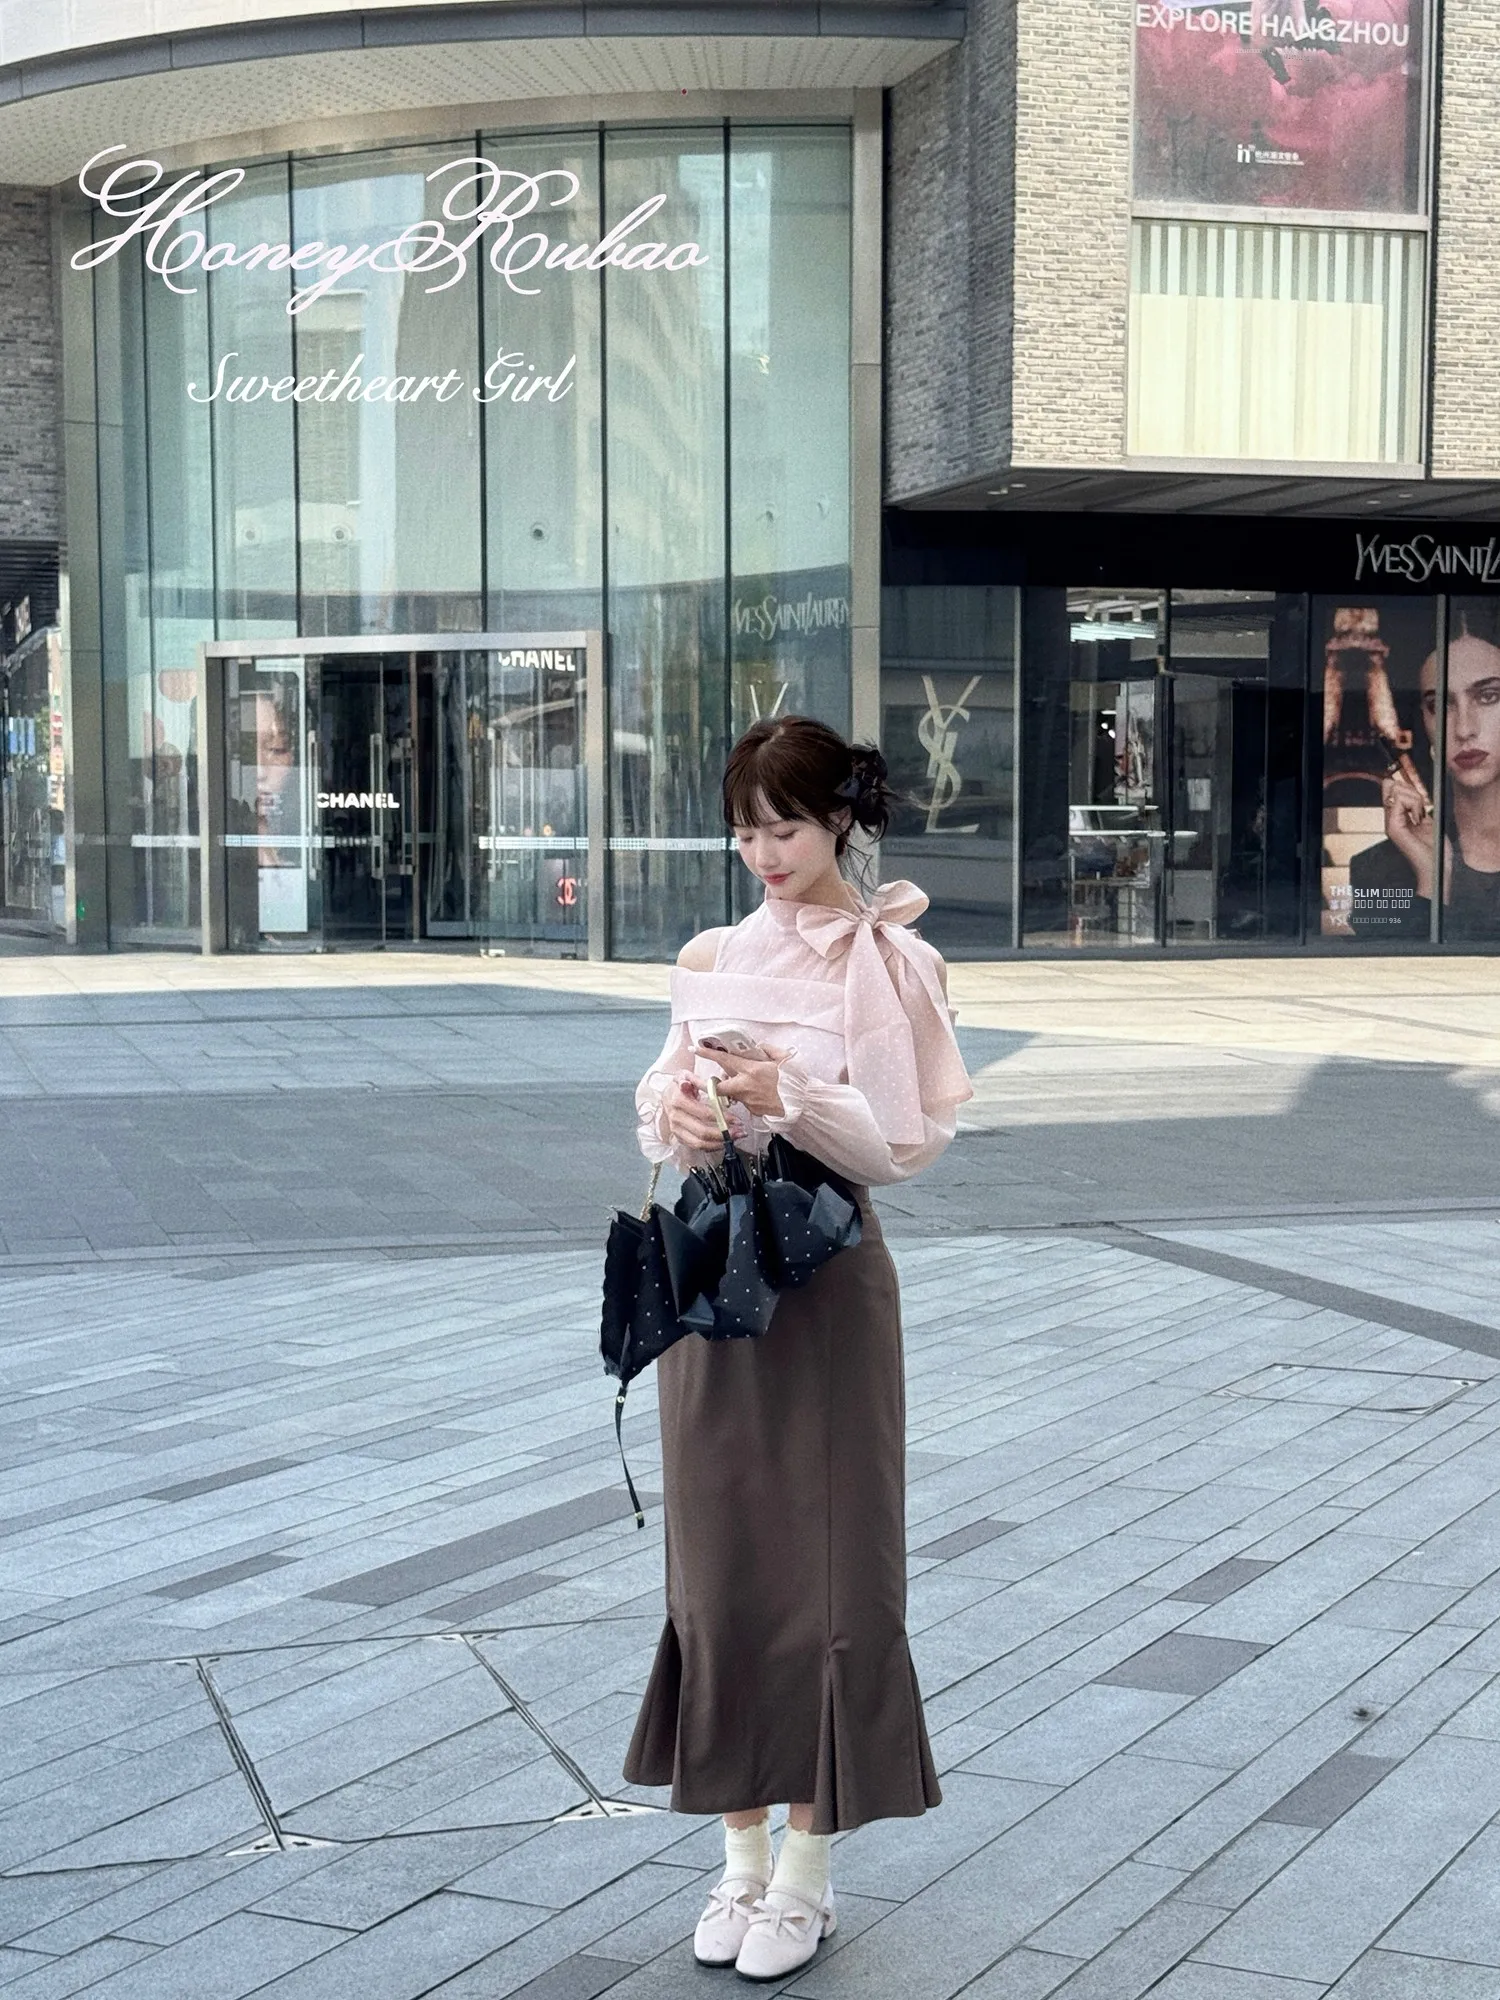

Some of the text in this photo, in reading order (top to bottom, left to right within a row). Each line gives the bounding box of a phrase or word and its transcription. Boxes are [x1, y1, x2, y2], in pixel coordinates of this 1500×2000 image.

[1136, 4, 1409, 47] EXPLORE HANGZHOU
[317, 792, 400, 809] CHANEL
[1354, 888, 1380, 898] SLIM
